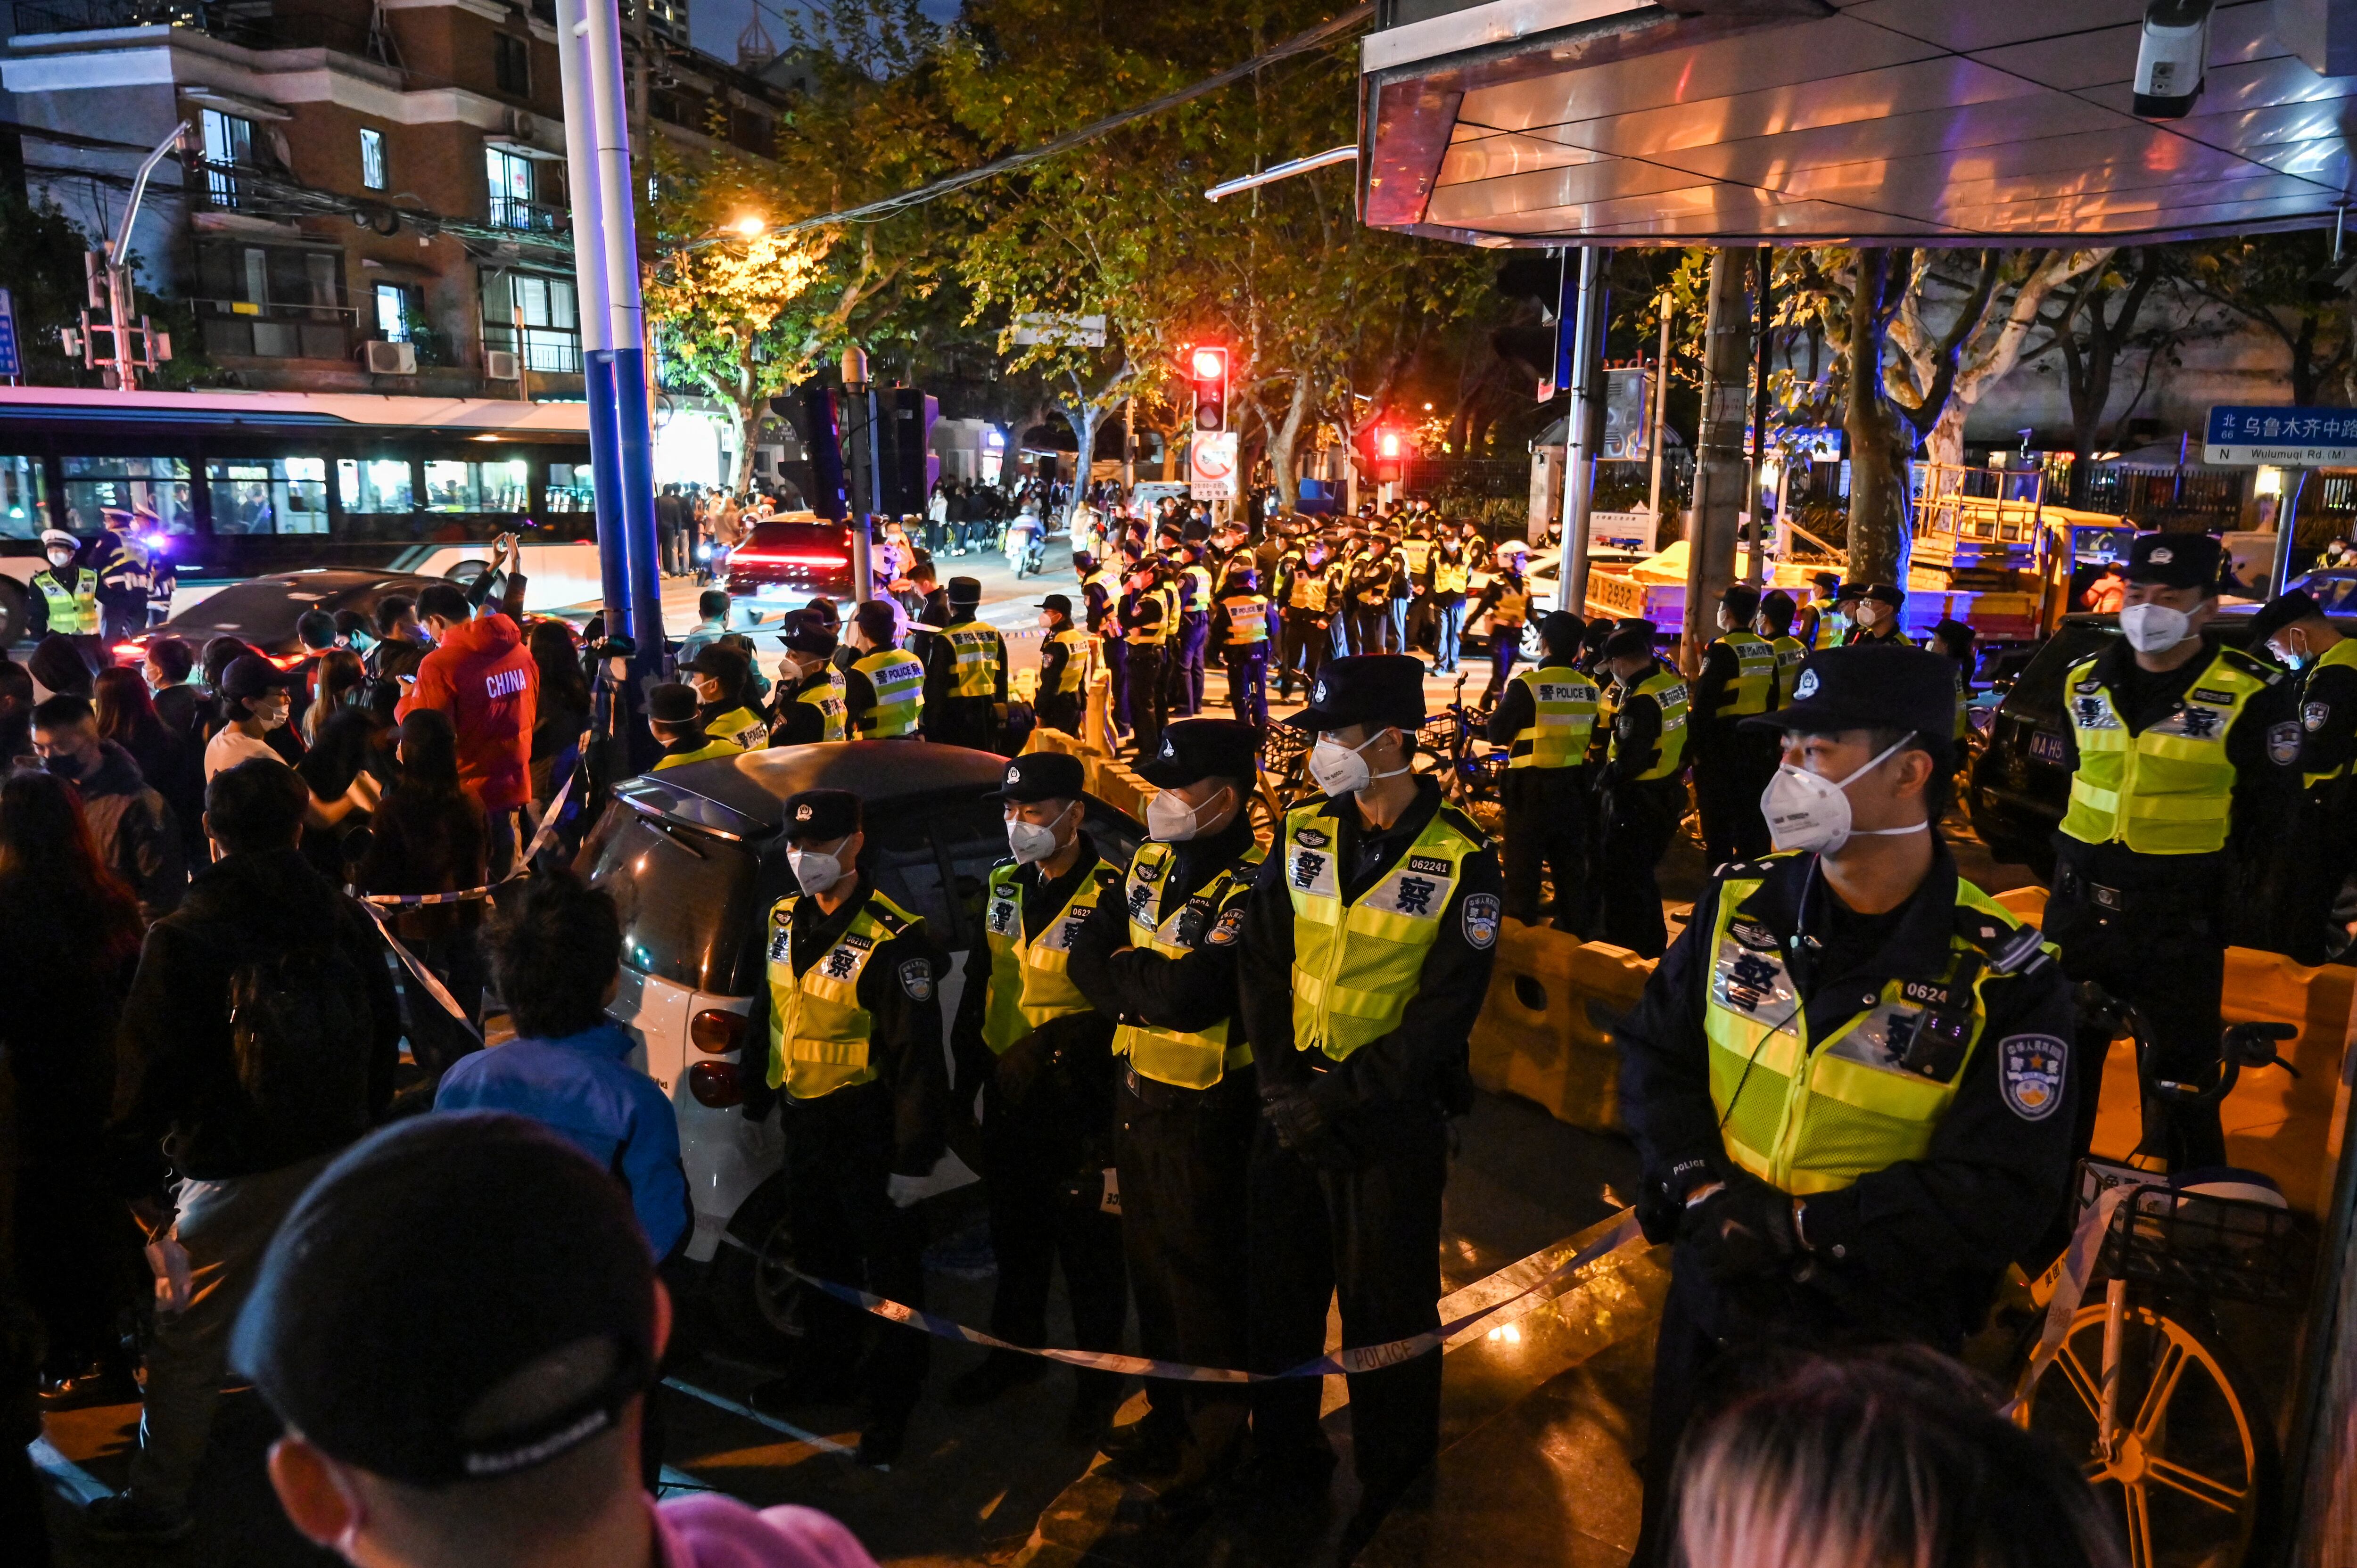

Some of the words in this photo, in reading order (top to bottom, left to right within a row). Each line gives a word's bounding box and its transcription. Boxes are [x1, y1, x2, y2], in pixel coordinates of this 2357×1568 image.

[2222, 413, 2235, 427] 北
[2243, 416, 2357, 439] 乌鲁木齐中路
[2221, 430, 2233, 439] 66
[2220, 448, 2230, 460] N
[2251, 449, 2302, 460] Wulumuqi
[2327, 450, 2346, 460] (M)
[964, 632, 985, 641] POLCE
[889, 666, 911, 680] POLICE
[486, 668, 526, 698] CHINA
[1556, 687, 1583, 698] POLICE
[1410, 858, 1448, 873] 062241
[1295, 851, 1326, 889] 警
[1396, 876, 1436, 915] 察
[846, 935, 871, 948] 062141
[828, 948, 857, 979] 察
[1725, 952, 1780, 1013] 警
[1907, 982, 1948, 1003] 0624
[1673, 1159, 1705, 1175] POLICE
[1354, 1339, 1413, 1370] POLICE
